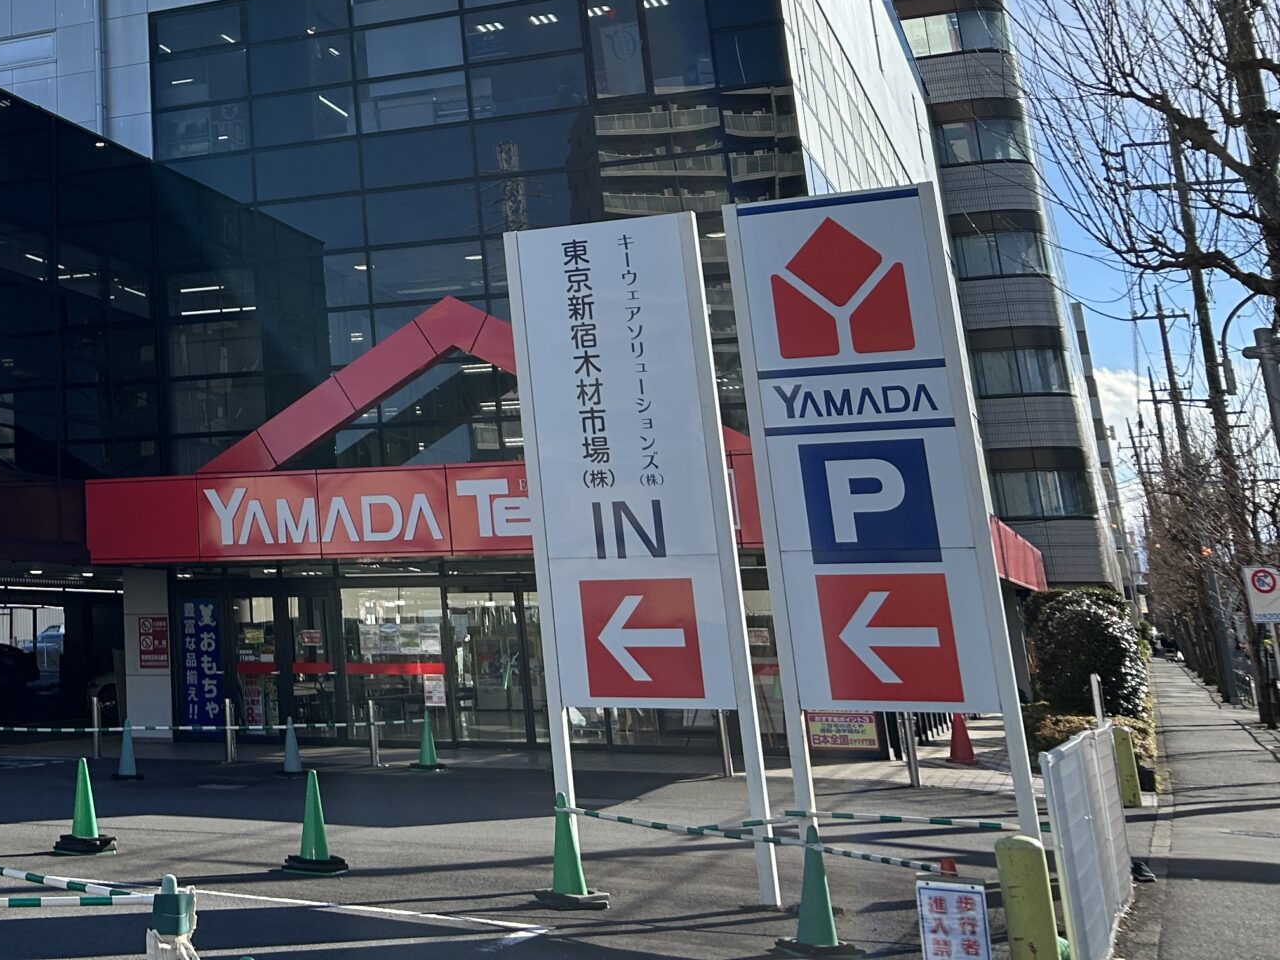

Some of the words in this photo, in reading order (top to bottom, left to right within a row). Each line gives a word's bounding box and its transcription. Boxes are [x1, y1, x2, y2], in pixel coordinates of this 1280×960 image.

[773, 383, 939, 420] YAMADA
[203, 487, 444, 545] YAMADA
[591, 498, 667, 560] IN
[825, 458, 906, 543] P
[199, 631, 220, 719] おもちゃ
[956, 895, 981, 957] 歩行者
